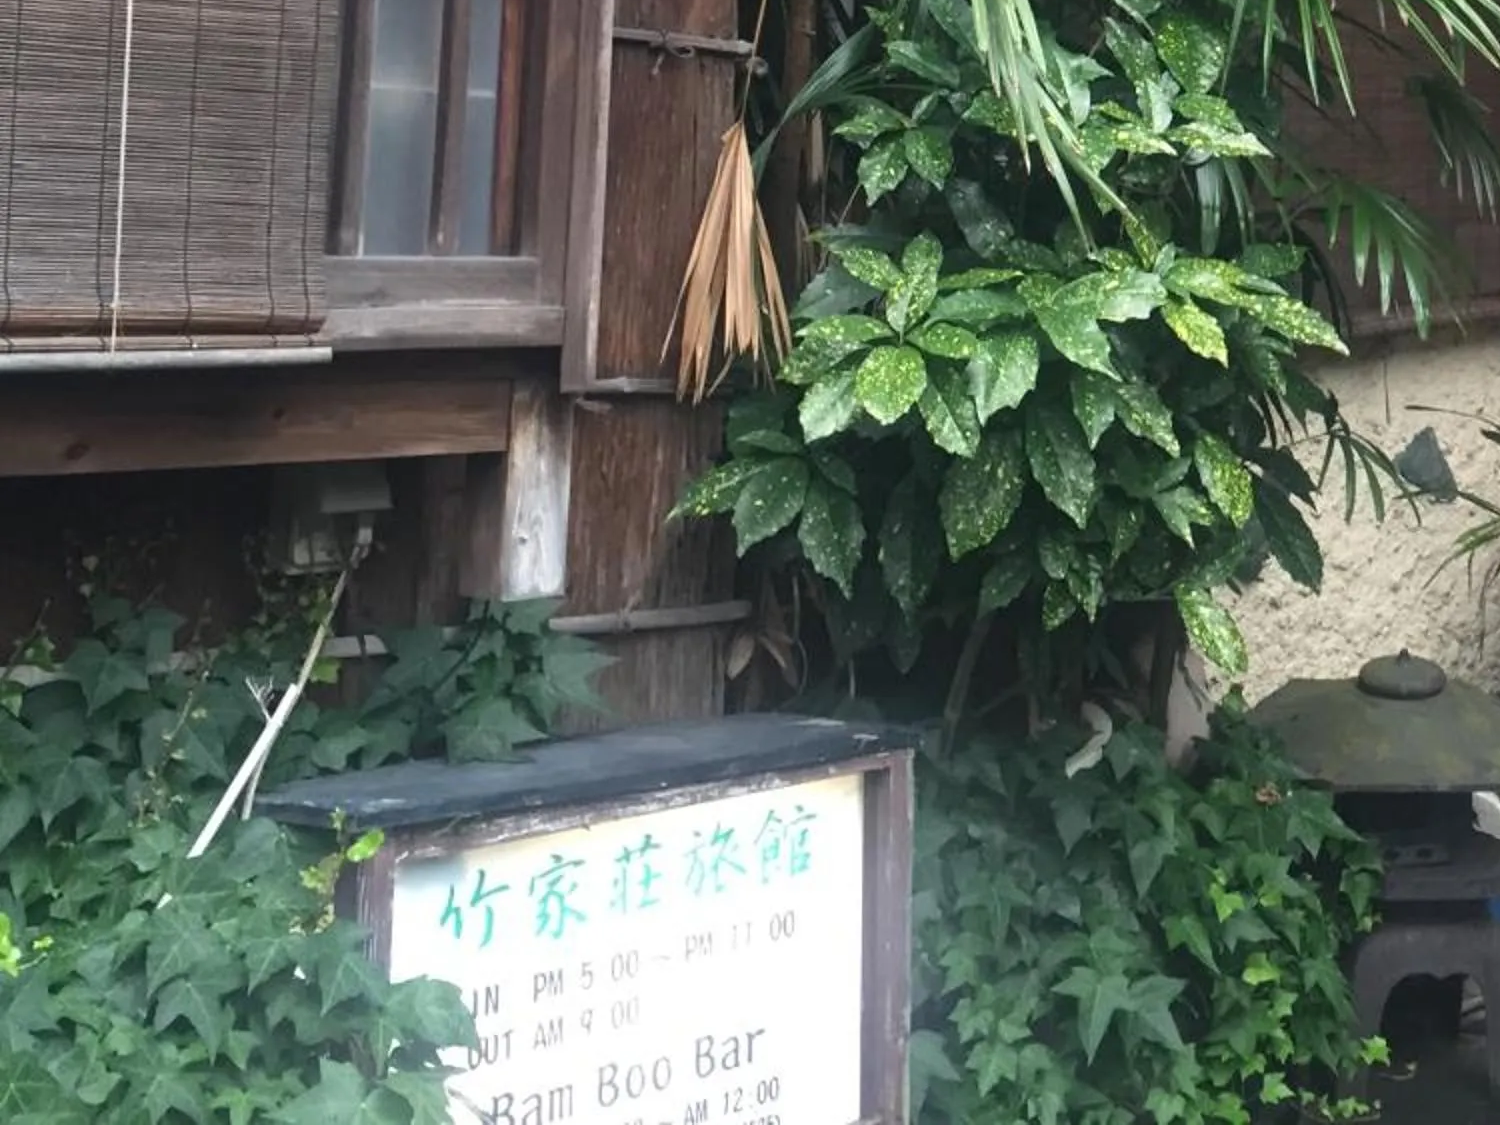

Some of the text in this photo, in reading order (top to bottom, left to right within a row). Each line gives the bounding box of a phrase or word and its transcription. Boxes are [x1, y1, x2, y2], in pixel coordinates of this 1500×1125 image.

[472, 984, 500, 1019] IN
[532, 969, 564, 1003] PM
[684, 931, 713, 961] PM
[532, 1017, 564, 1051] AM
[597, 1055, 673, 1108] Boo
[694, 1027, 766, 1079] Bar
